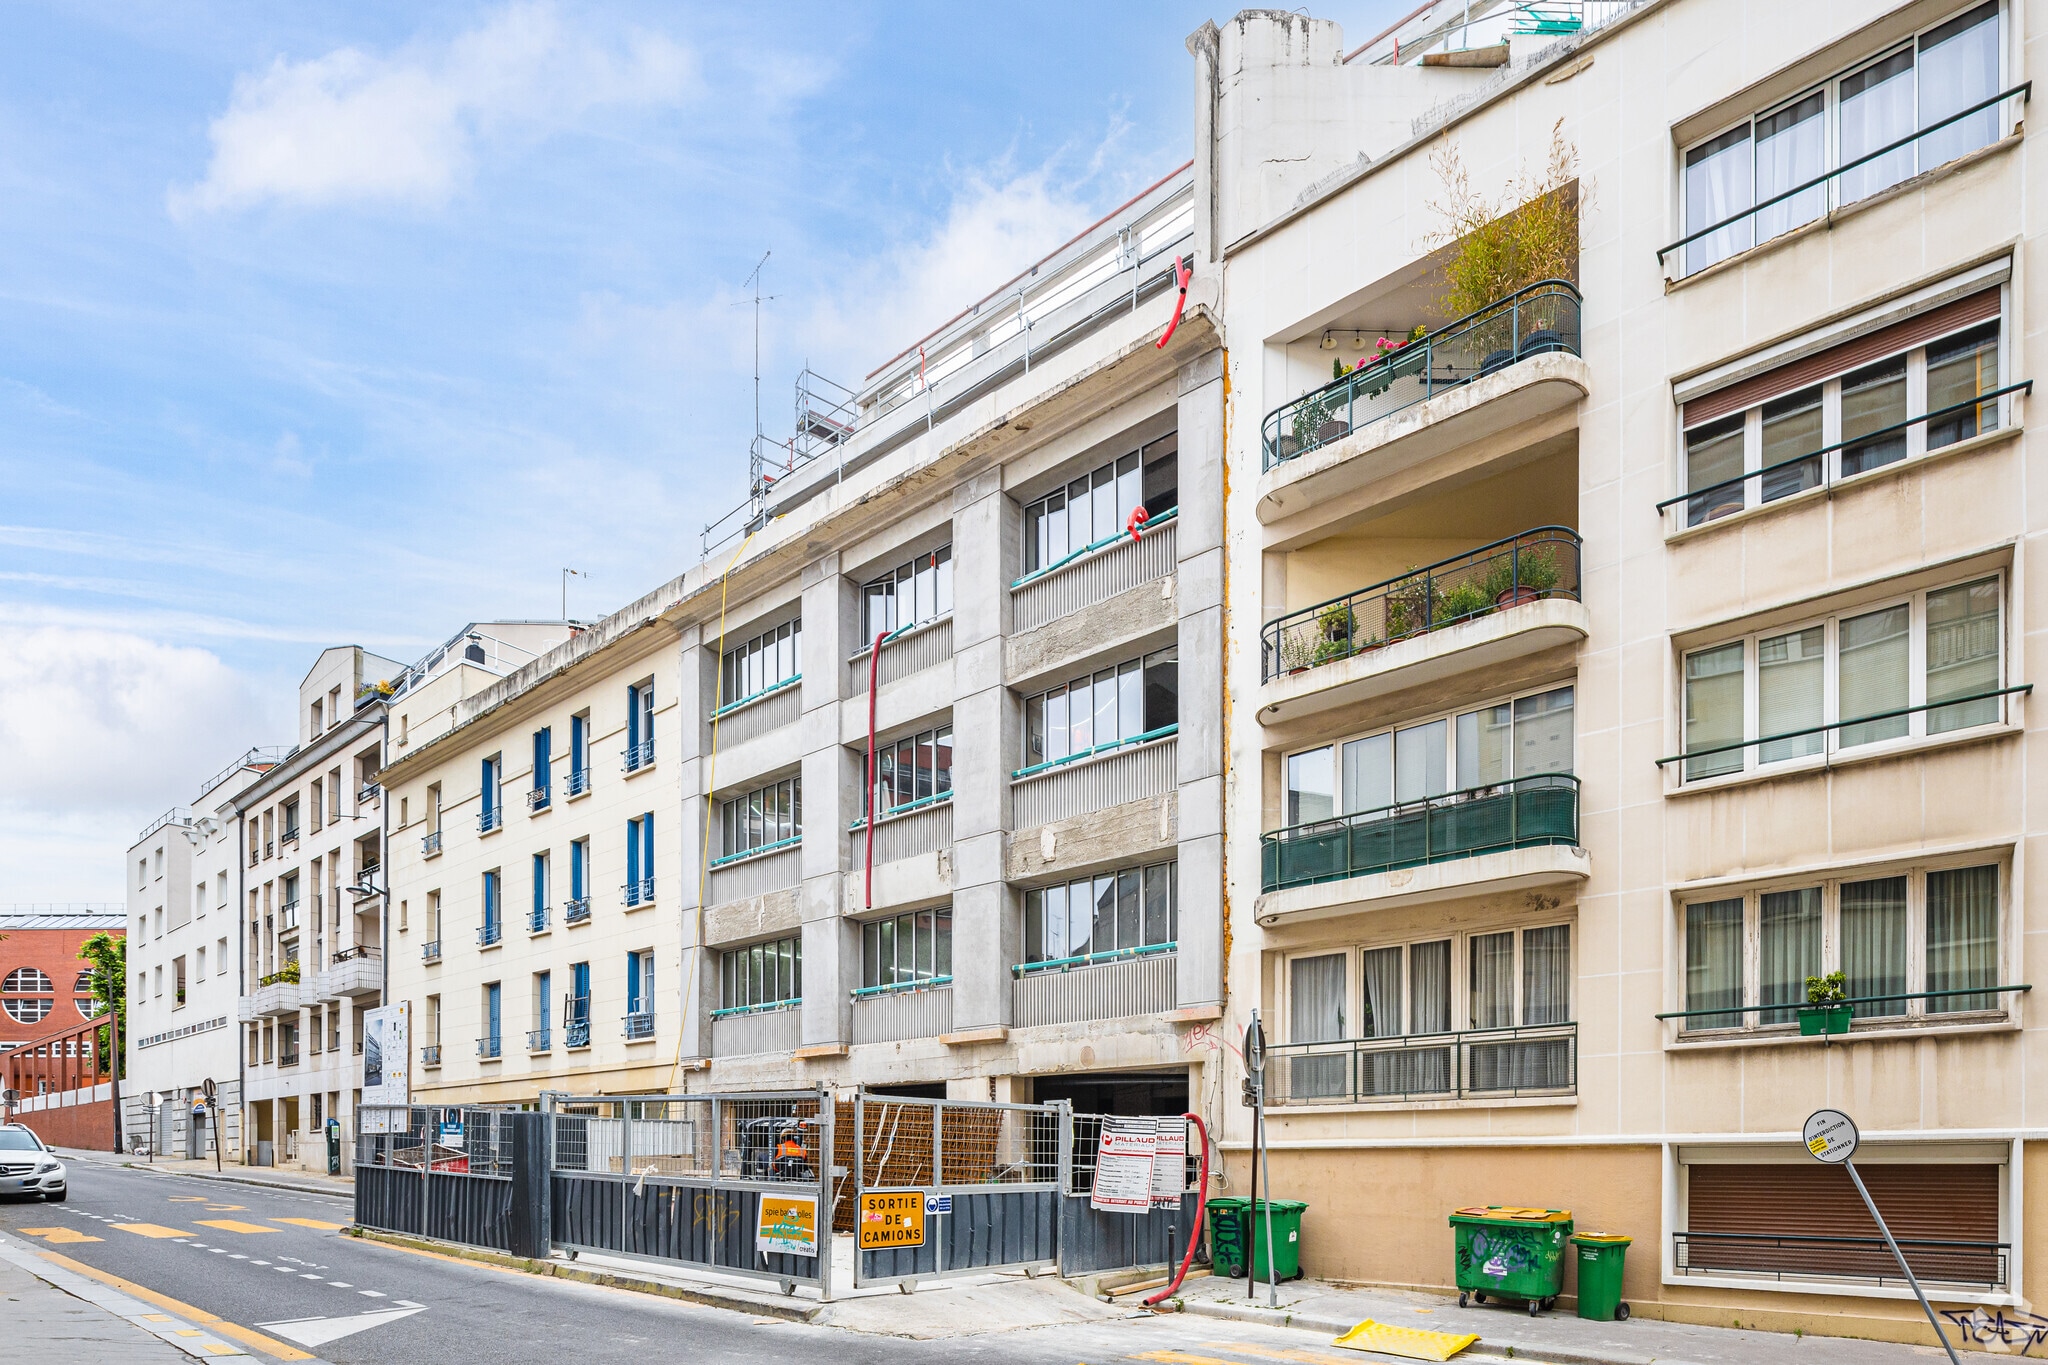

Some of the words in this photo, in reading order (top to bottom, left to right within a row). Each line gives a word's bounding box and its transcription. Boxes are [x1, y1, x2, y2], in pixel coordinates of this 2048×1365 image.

[1816, 1119, 1826, 1127] FIN
[1809, 1121, 1845, 1141] D'INTERDICTION
[1114, 1136, 1156, 1144] PILLAUD
[1827, 1136, 1835, 1144] DE
[1820, 1139, 1852, 1157] STATIONNER
[868, 1197, 917, 1210] SORTIE
[765, 1208, 780, 1218] spie
[885, 1214, 901, 1225] DE
[864, 1229, 921, 1243] CAMIONS
